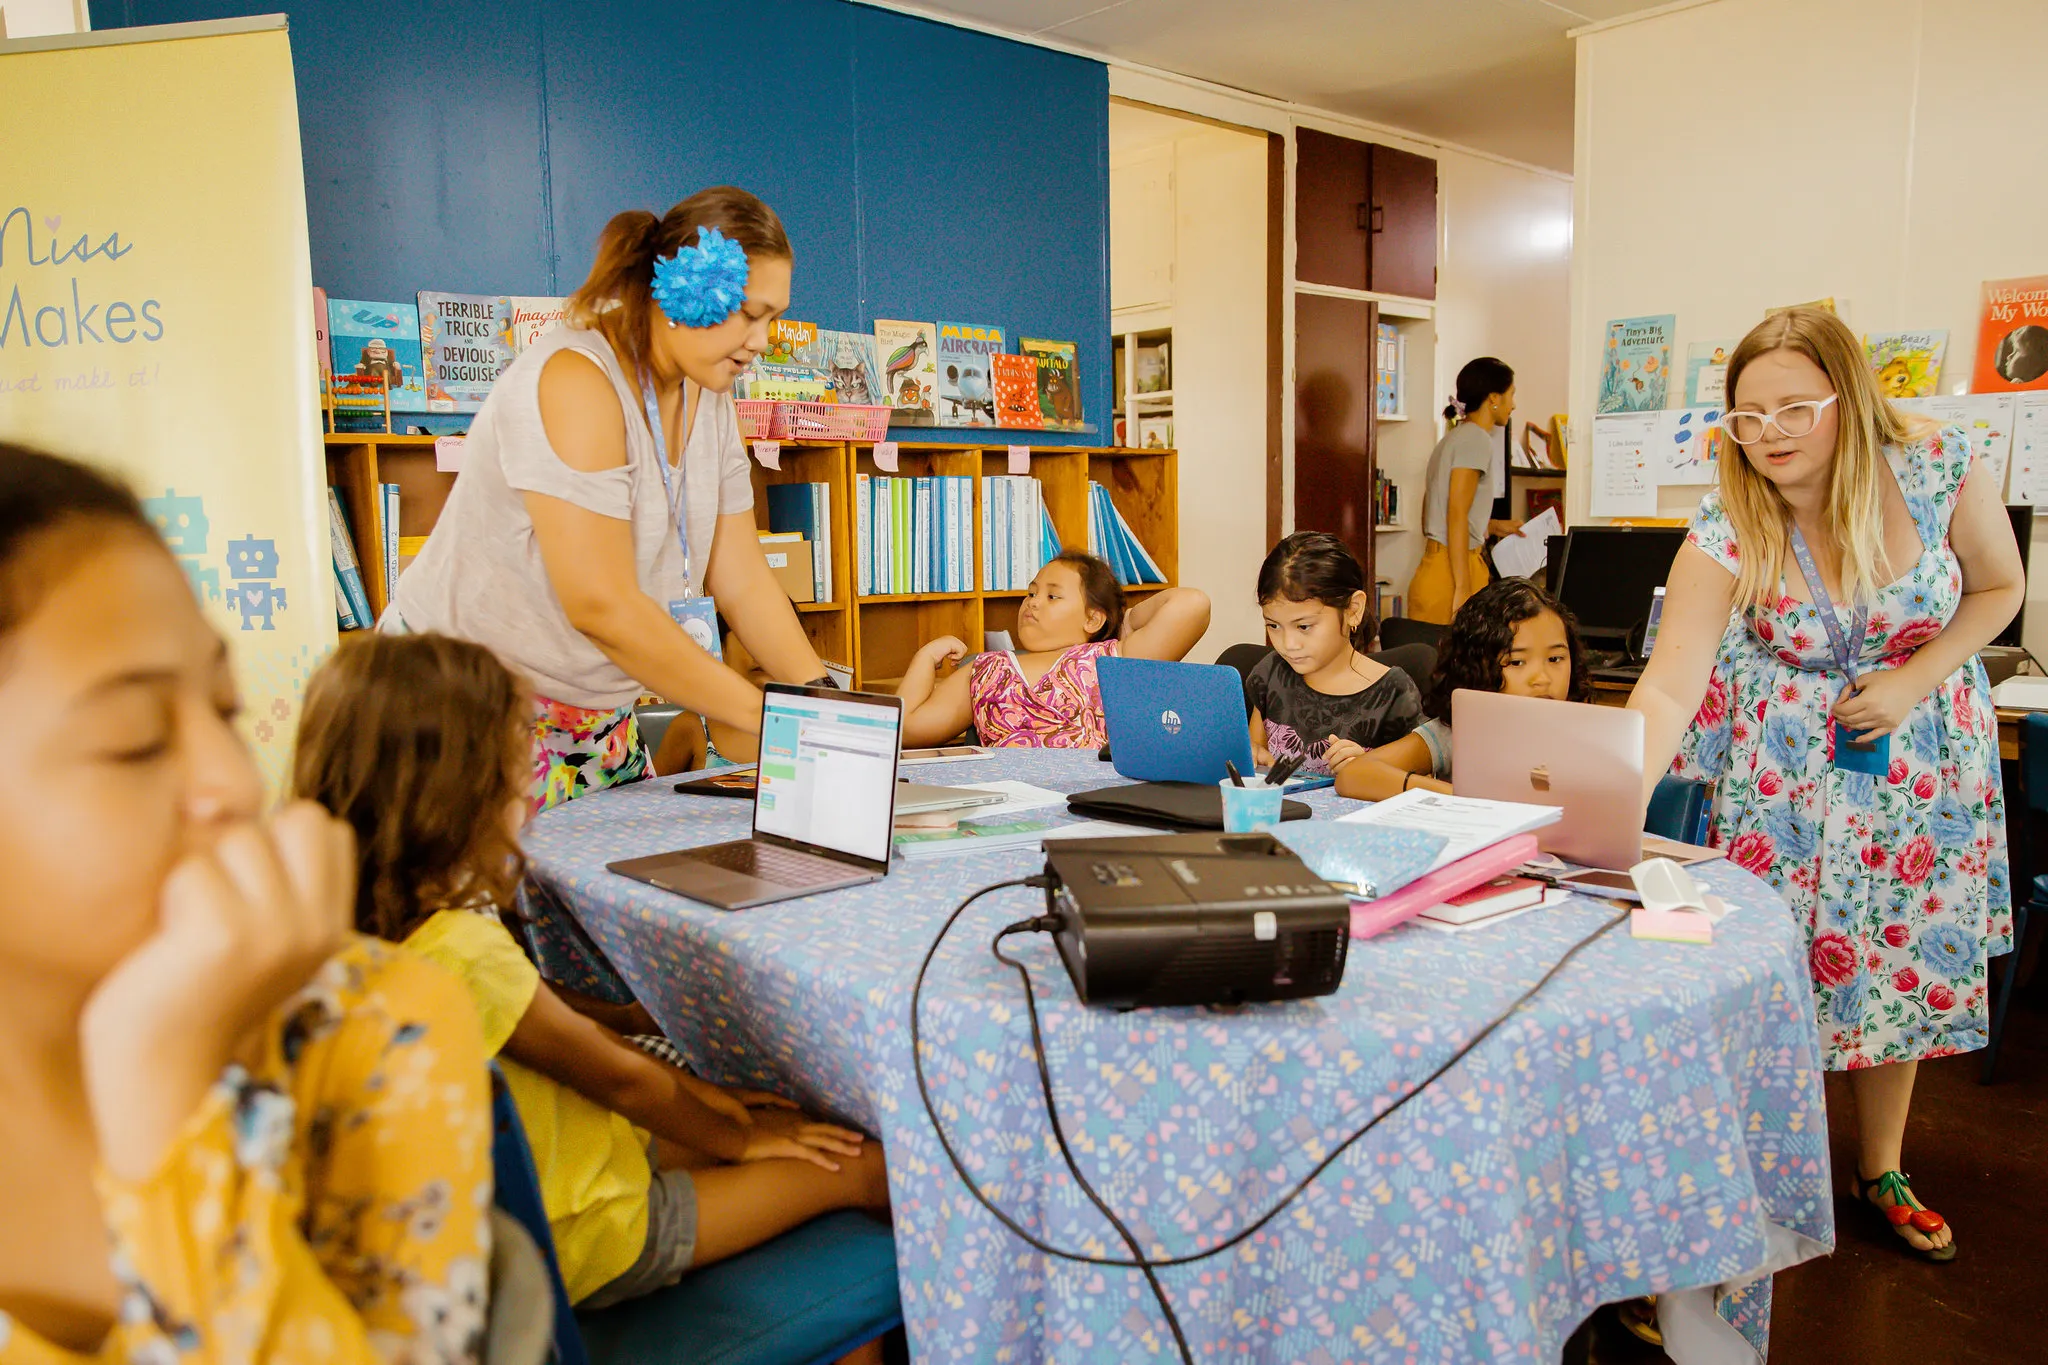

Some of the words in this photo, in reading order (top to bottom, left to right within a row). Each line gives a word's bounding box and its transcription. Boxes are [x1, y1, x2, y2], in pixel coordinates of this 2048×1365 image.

[1988, 287, 2048, 304] Welcom
[438, 301, 494, 320] TERRIBLE
[513, 308, 564, 326] Imagin
[1990, 304, 2018, 323] My
[2022, 301, 2048, 318] Wo
[445, 321, 489, 337] TRICKS
[777, 320, 812, 352] Mayday
[941, 325, 1003, 343] MEGA
[941, 338, 1003, 356] AIRCRAFT
[1621, 336, 1665, 347] Adventure
[443, 346, 495, 364] DEVIOUS
[0, 372, 42, 393] ust
[55, 366, 115, 392] make
